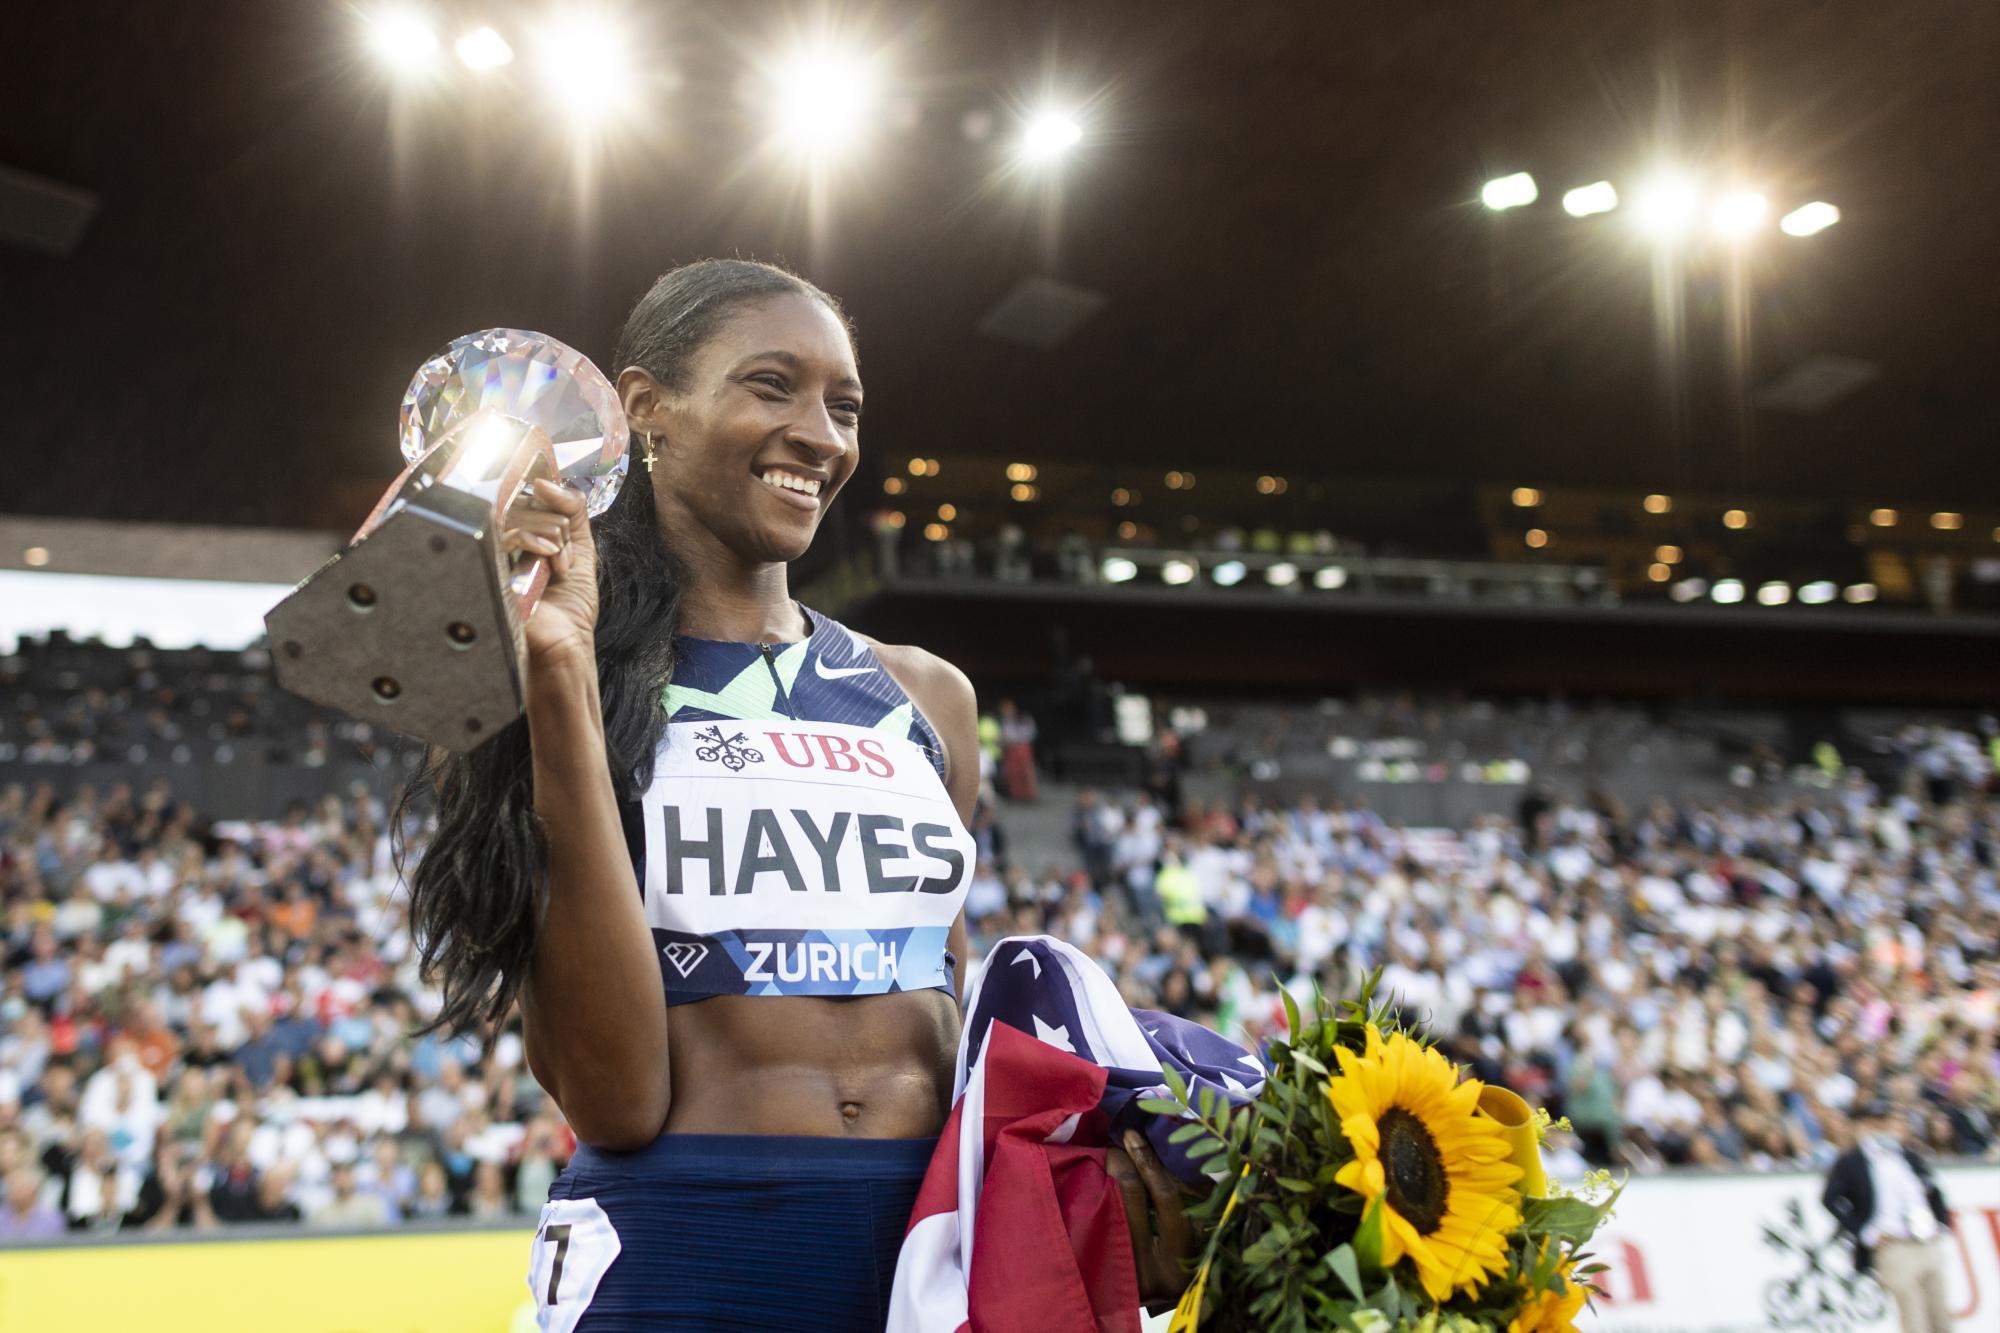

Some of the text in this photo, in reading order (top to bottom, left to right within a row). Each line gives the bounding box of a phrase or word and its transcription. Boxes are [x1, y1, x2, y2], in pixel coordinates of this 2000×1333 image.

[763, 732, 895, 779] UBS
[663, 805, 965, 896] HAYES
[743, 941, 898, 983] ZURICH
